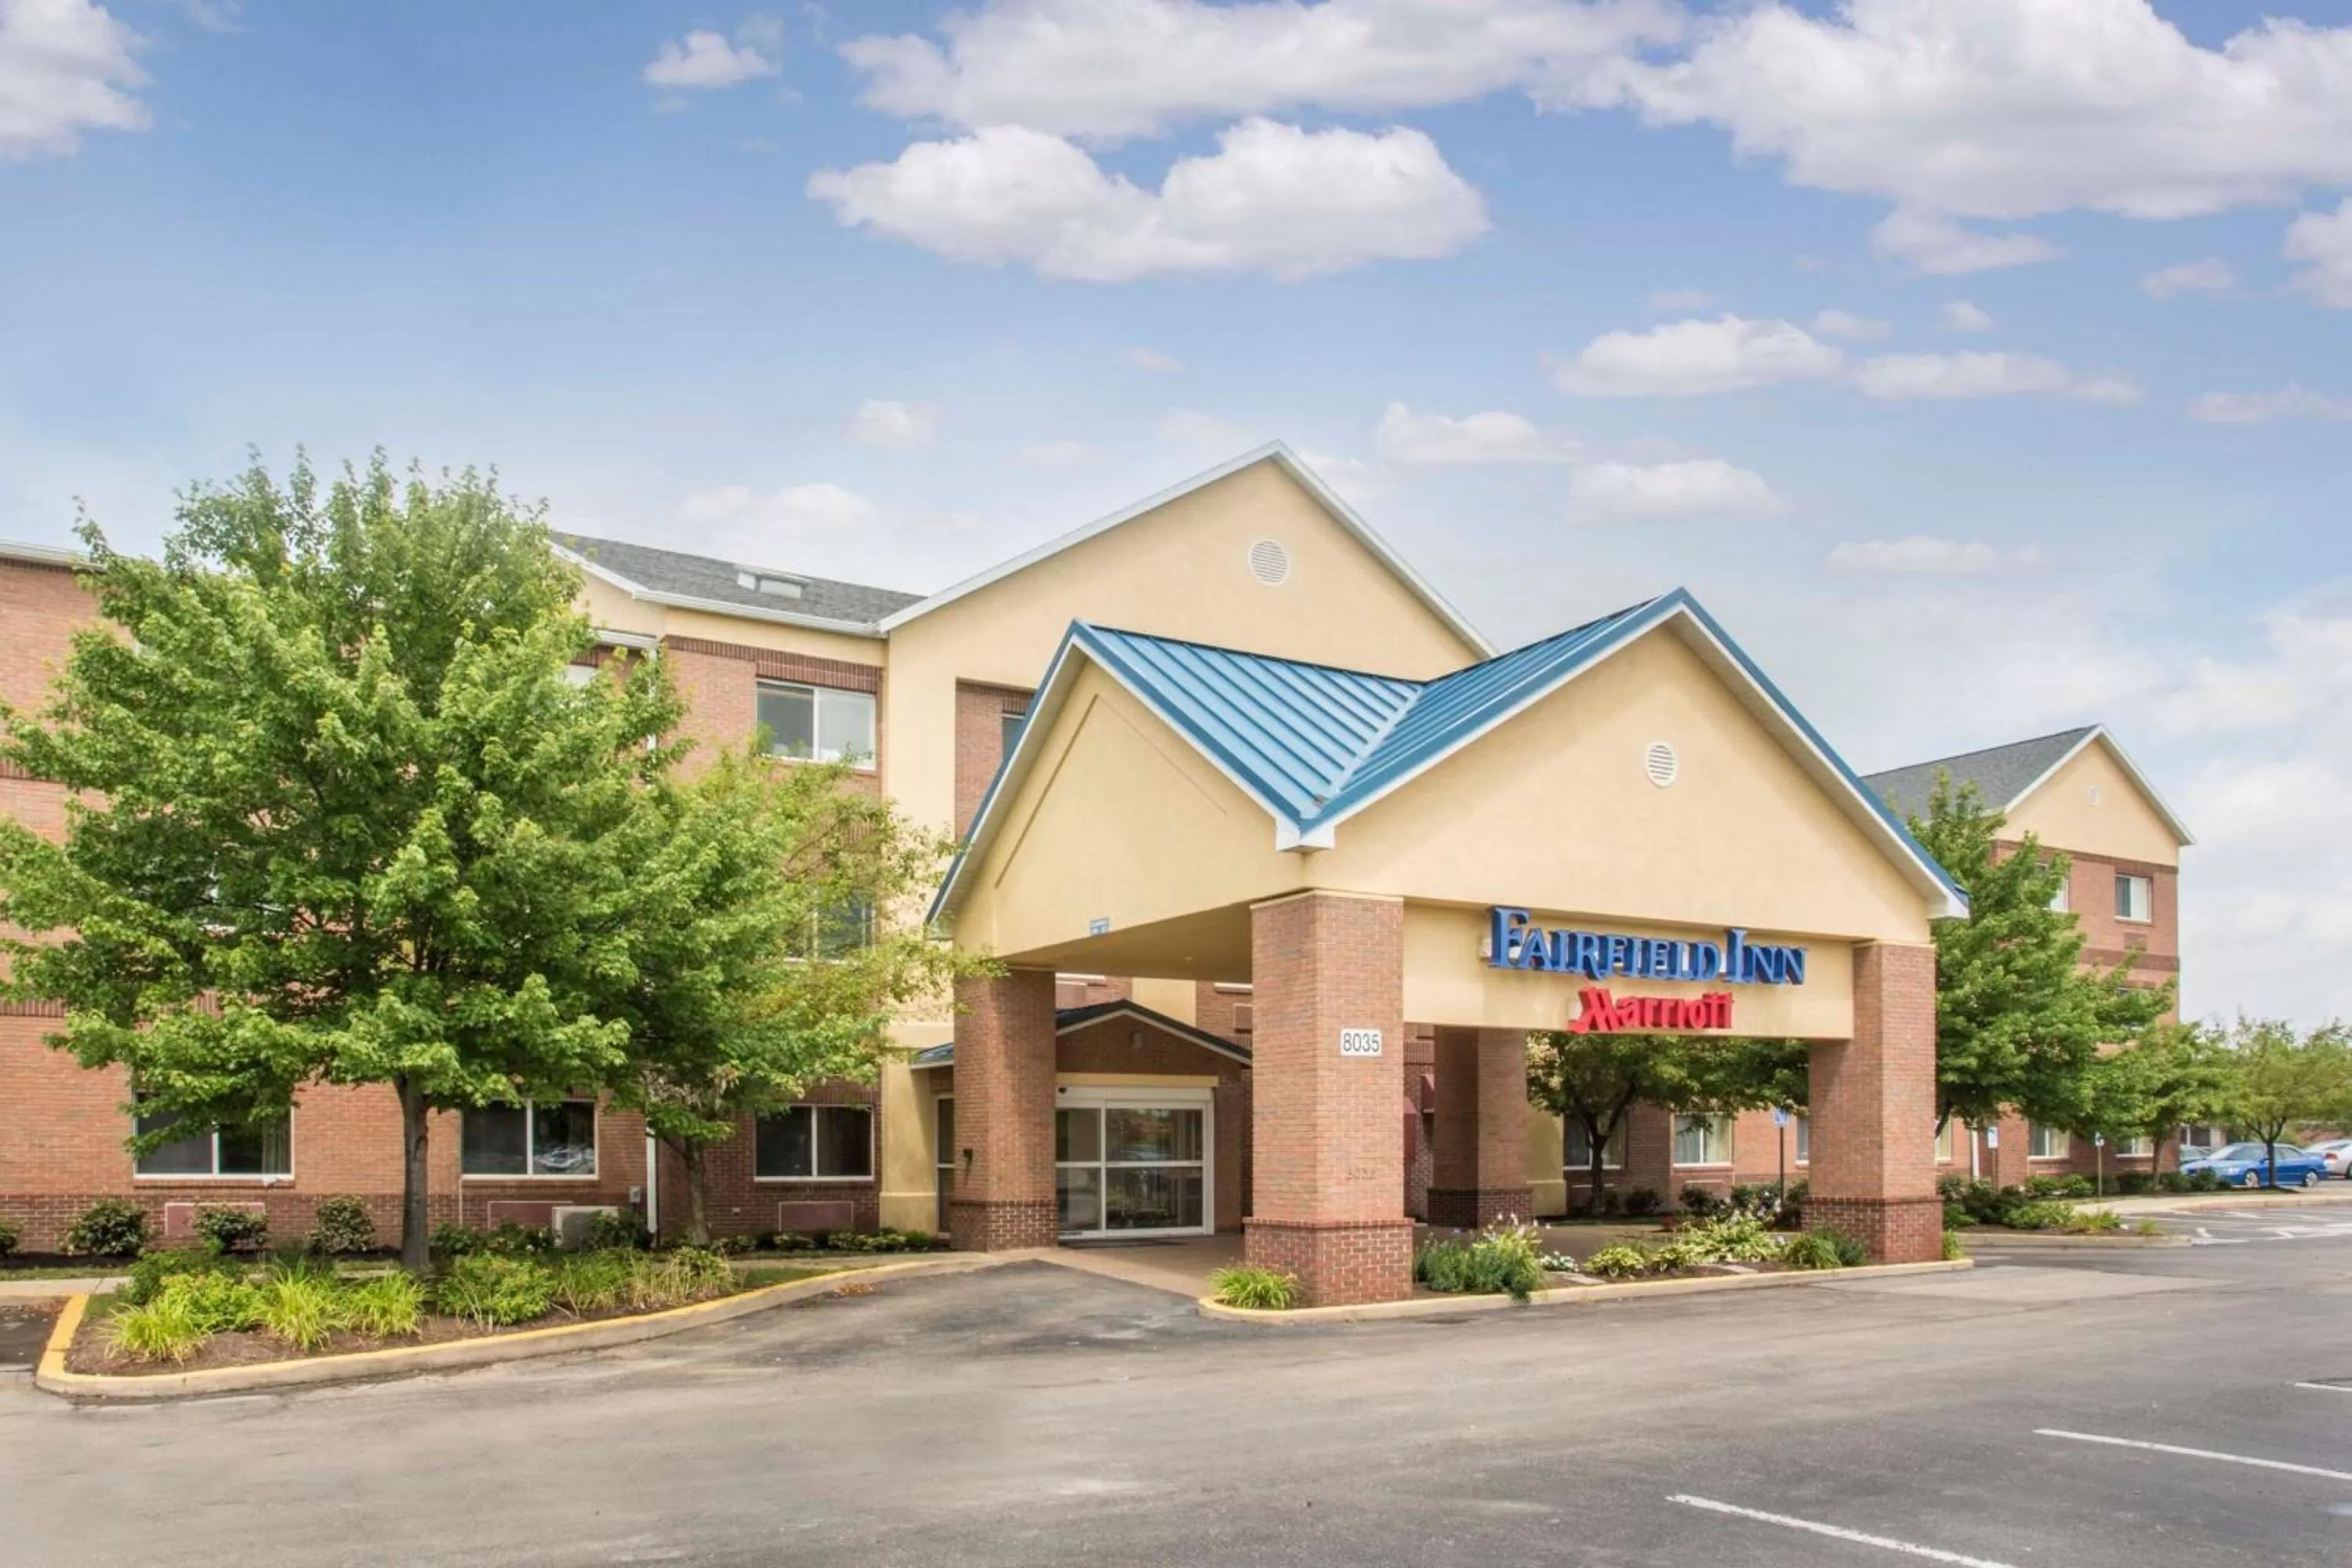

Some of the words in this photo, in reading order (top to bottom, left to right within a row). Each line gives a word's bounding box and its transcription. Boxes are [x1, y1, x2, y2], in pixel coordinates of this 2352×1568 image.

[1488, 906, 1720, 981] FAIRFIELD
[1725, 928, 1807, 985] INN
[1568, 985, 1733, 1034] Marriott
[1342, 1032, 1380, 1052] 8035
